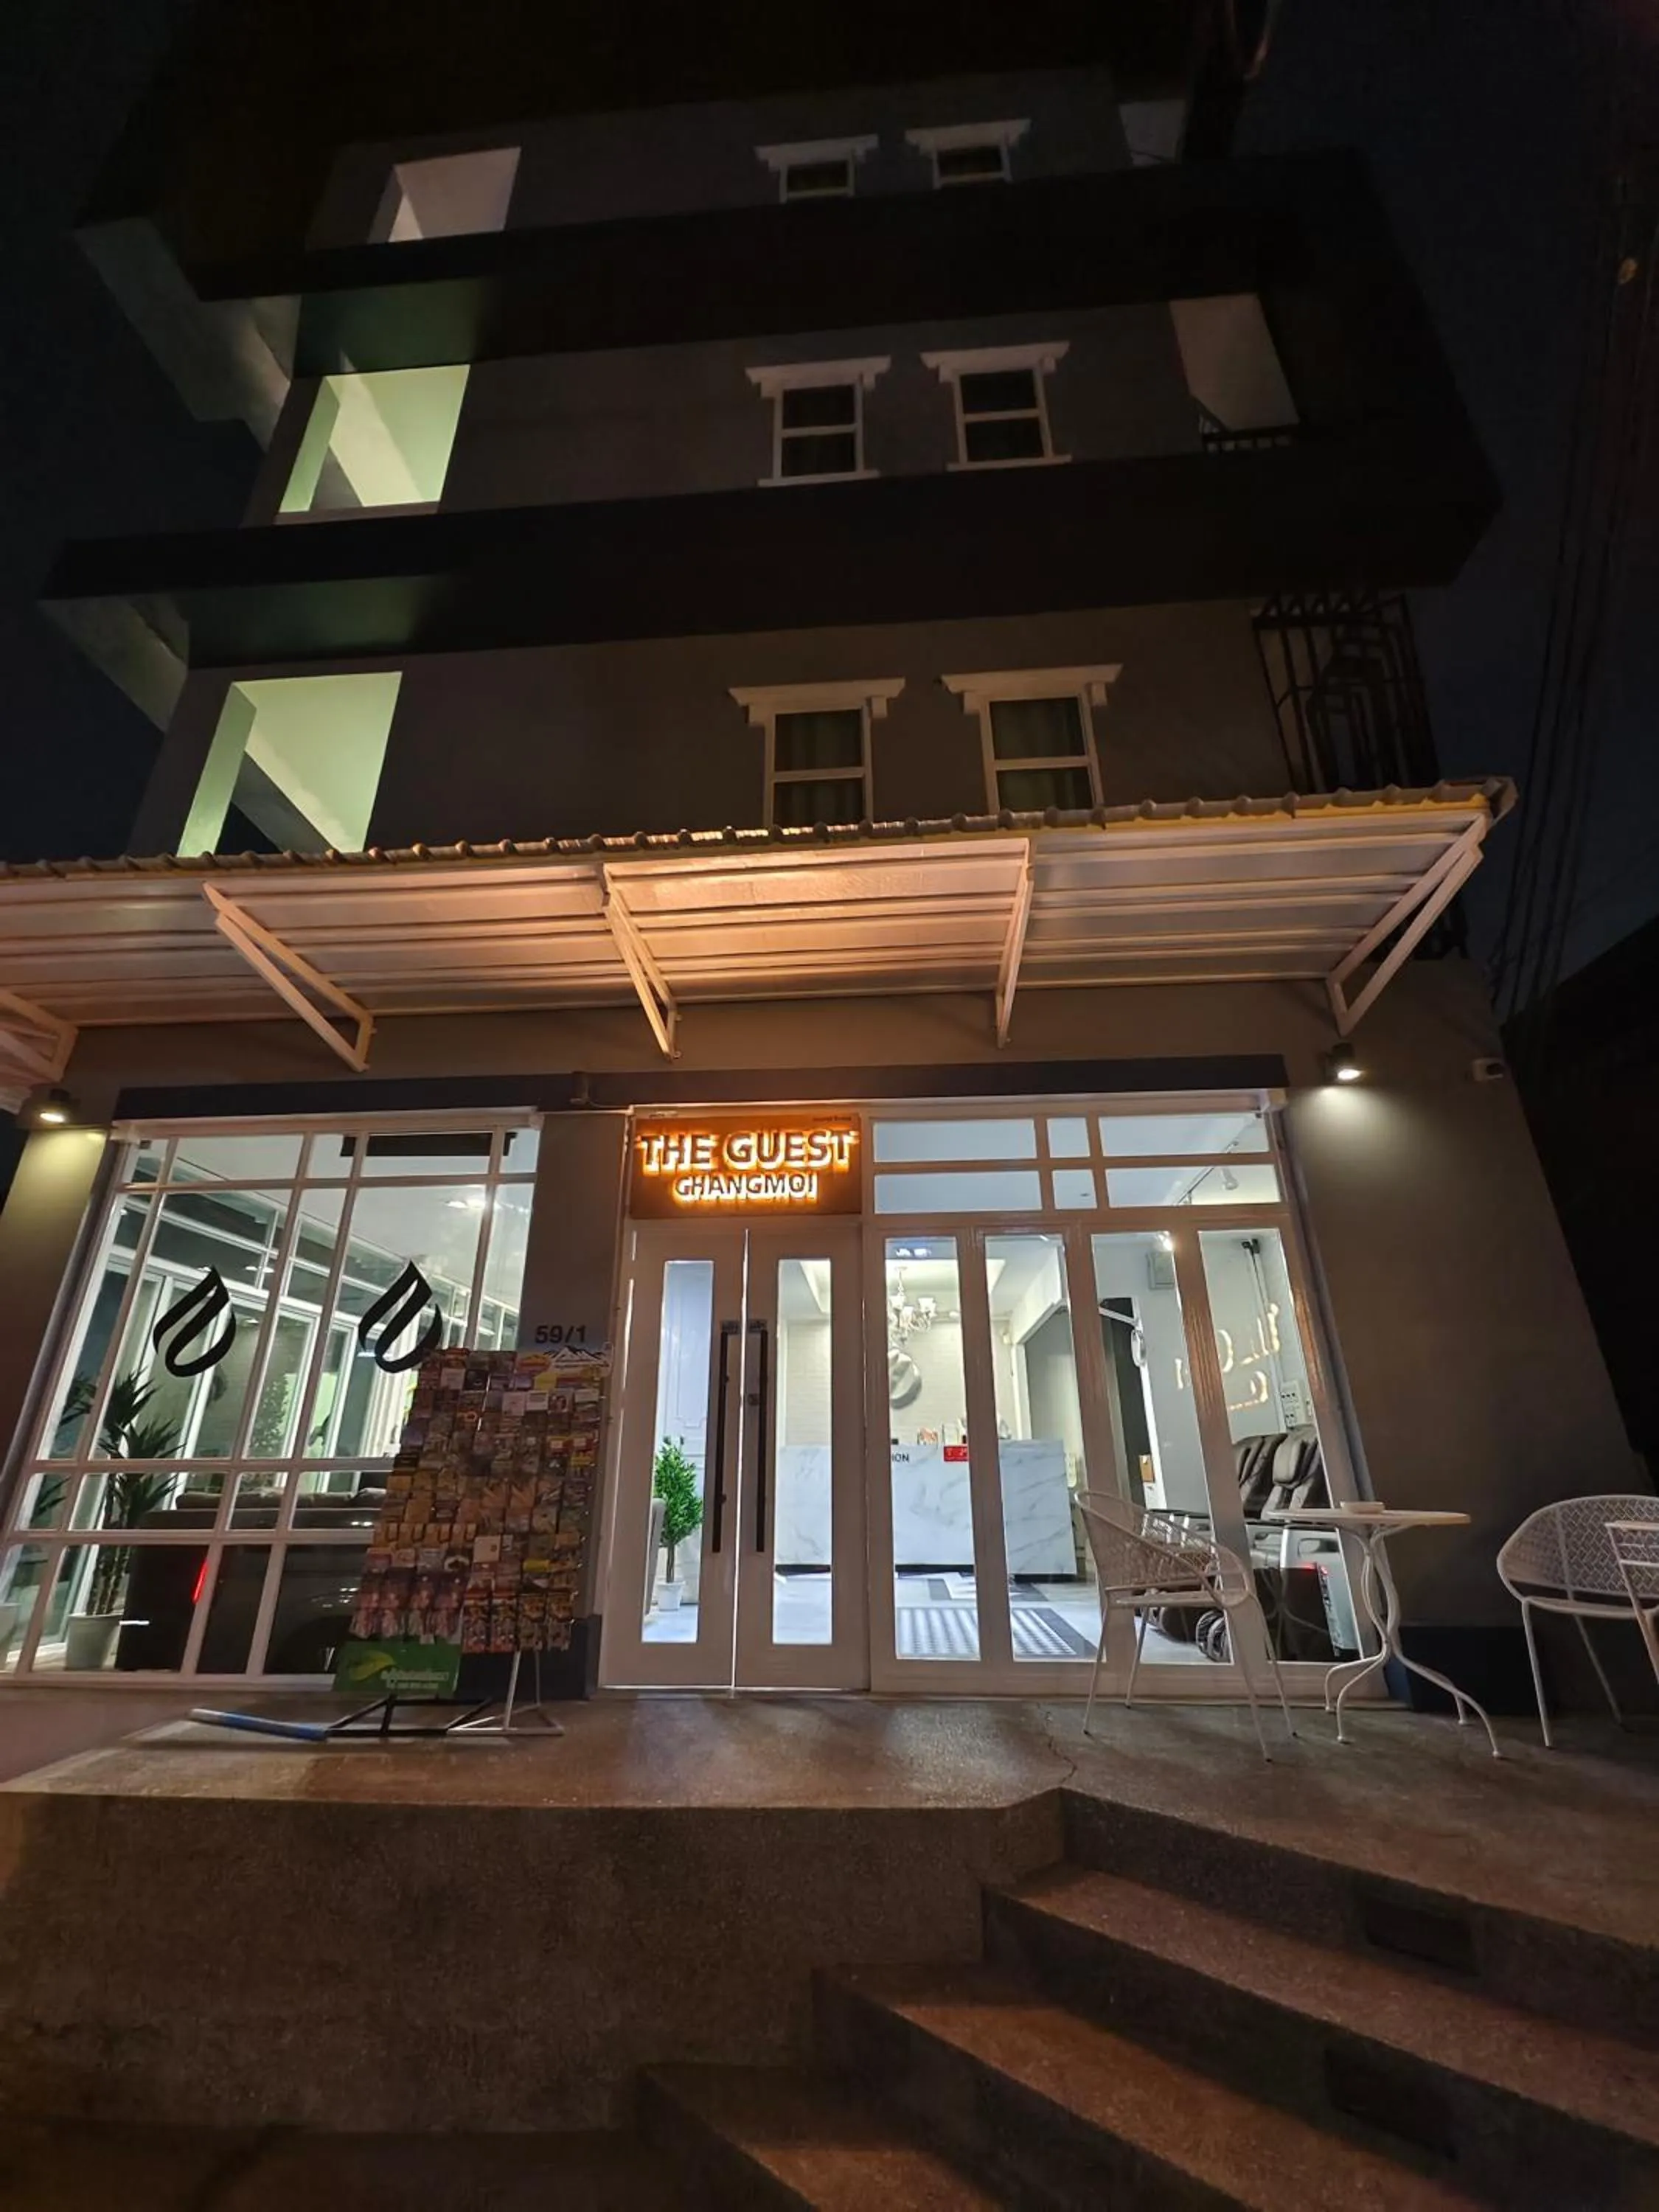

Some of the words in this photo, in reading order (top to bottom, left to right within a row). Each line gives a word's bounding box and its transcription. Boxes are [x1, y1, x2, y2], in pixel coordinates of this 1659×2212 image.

[637, 1130, 718, 1172] THE
[723, 1127, 858, 1170] GUEST
[535, 1324, 586, 1343] 59/1
